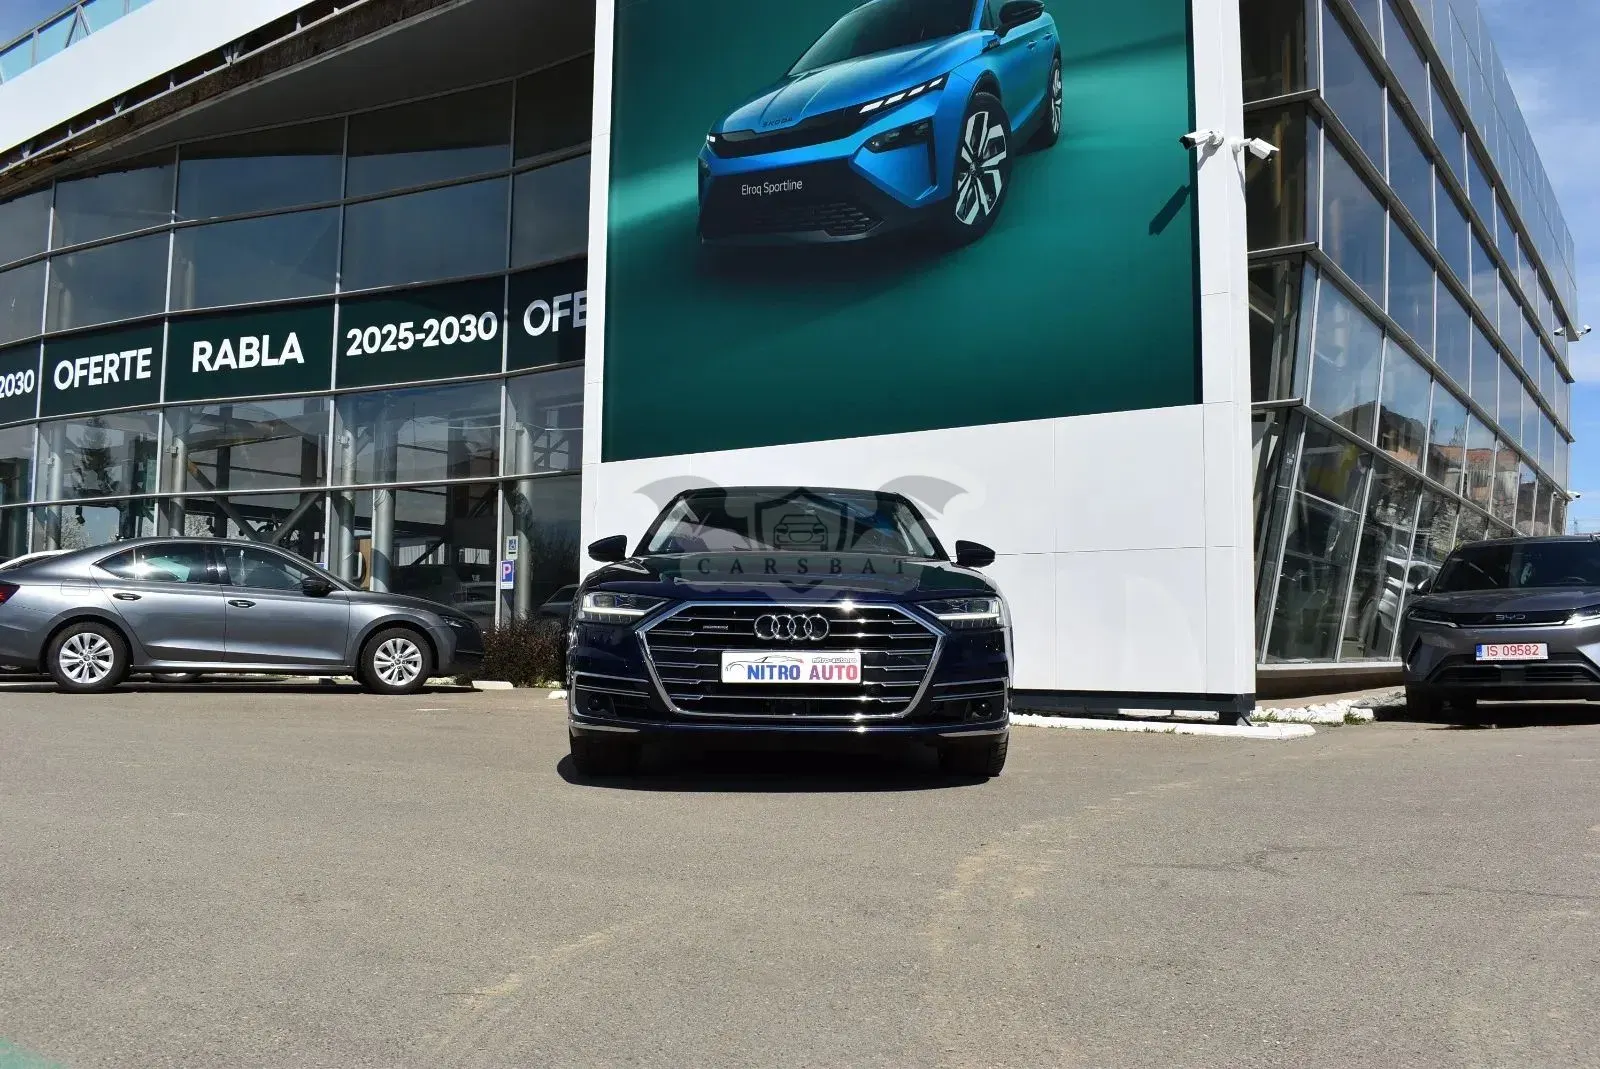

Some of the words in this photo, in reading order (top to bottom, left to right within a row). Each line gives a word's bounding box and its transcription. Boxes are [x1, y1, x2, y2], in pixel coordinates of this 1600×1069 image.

[741, 184, 762, 197] Elroq
[763, 179, 803, 195] Sportline
[0, 368, 35, 399] 2030
[53, 347, 153, 391] OFERTE
[192, 331, 305, 373] RABLA
[346, 311, 498, 356] 2025-2030
[523, 290, 588, 337] OFE
[502, 563, 512, 580] P
[1487, 646, 1498, 657] IS
[1502, 645, 1540, 657] 09582
[747, 664, 801, 681] NITRO
[808, 664, 858, 681] AUTO
